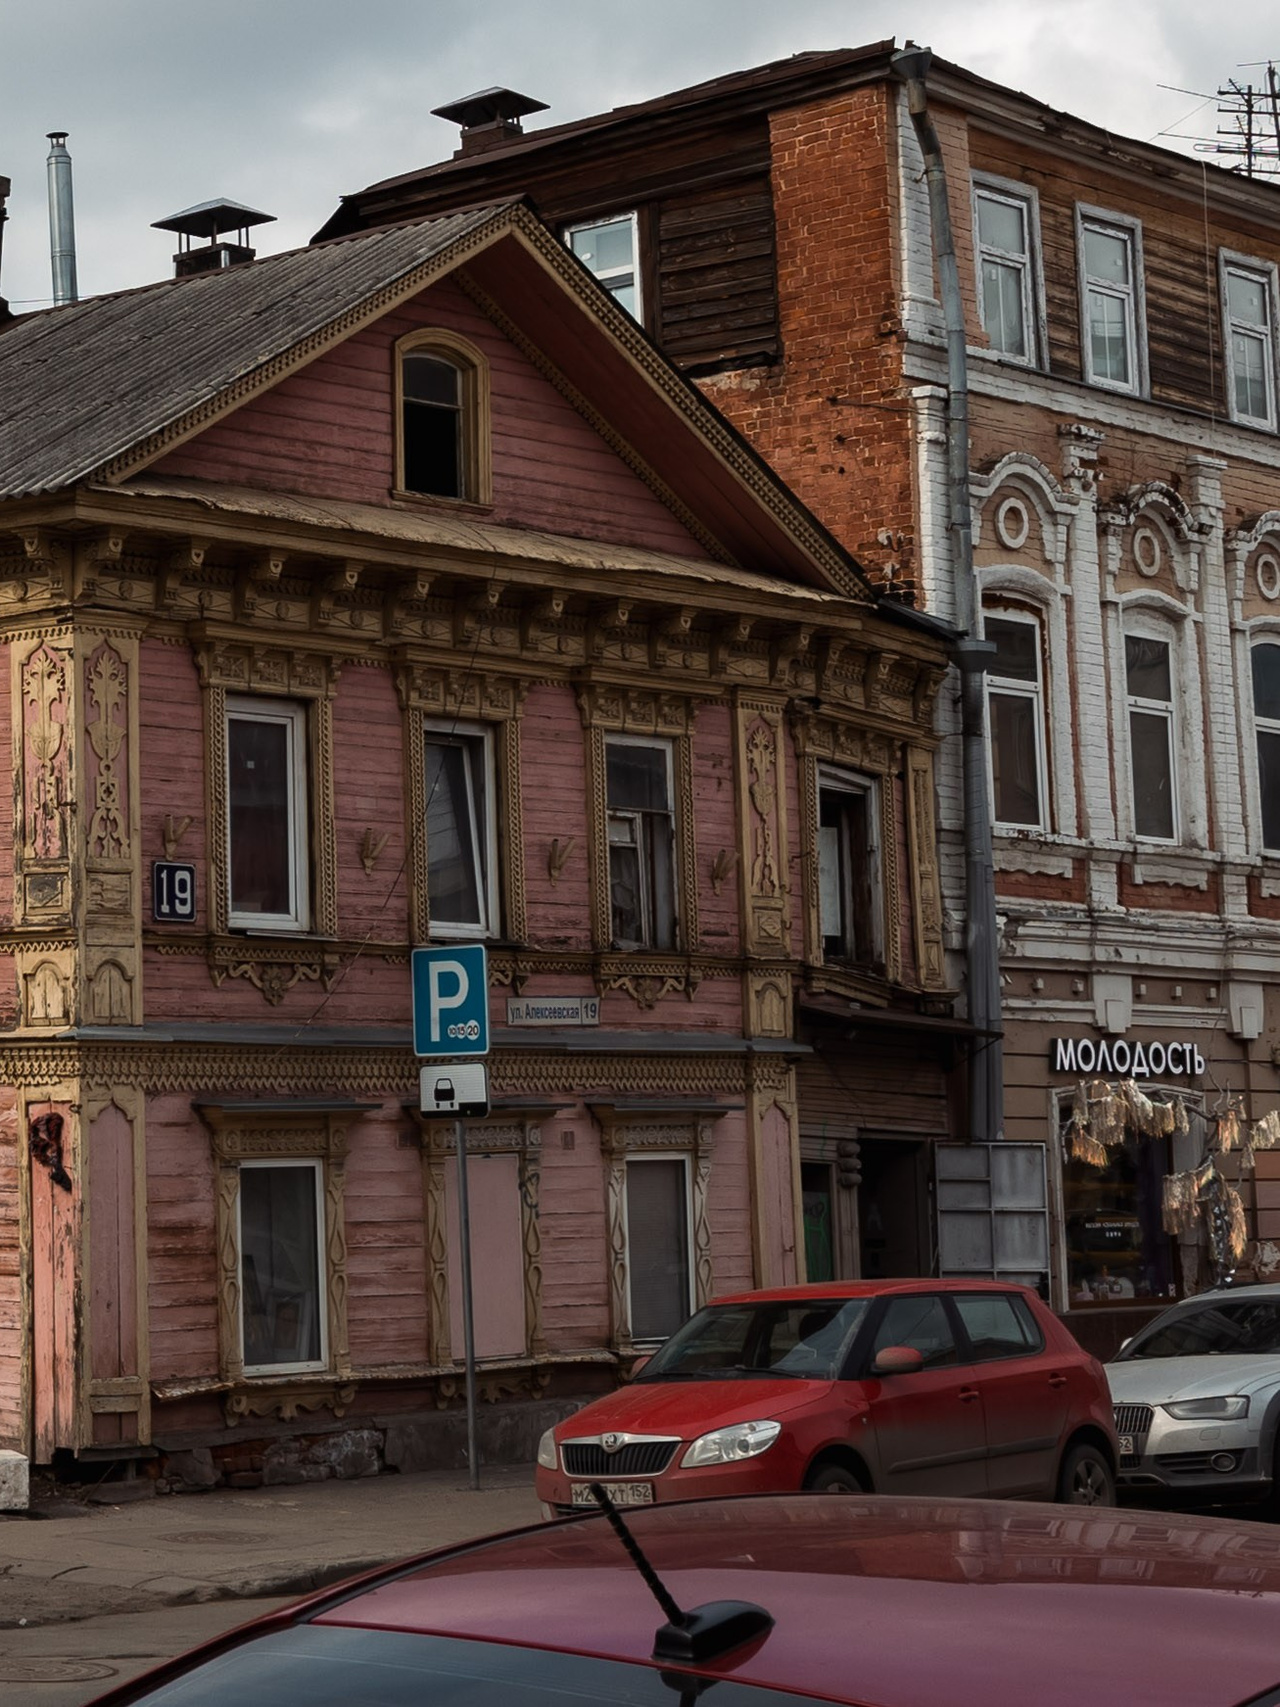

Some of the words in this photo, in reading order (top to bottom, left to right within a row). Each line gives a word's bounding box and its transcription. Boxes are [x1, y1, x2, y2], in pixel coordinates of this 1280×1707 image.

[161, 869, 192, 915] 19
[429, 960, 469, 1042] P
[510, 1006, 523, 1023] ул.
[525, 1003, 580, 1020] Алексеевская
[583, 1002, 597, 1019] 19
[467, 1025, 479, 1036] 20
[1056, 1038, 1206, 1077] МОЛОДОСТЬ
[573, 1486, 626, 1502] М2ХТ
[629, 1484, 649, 1498] 152
